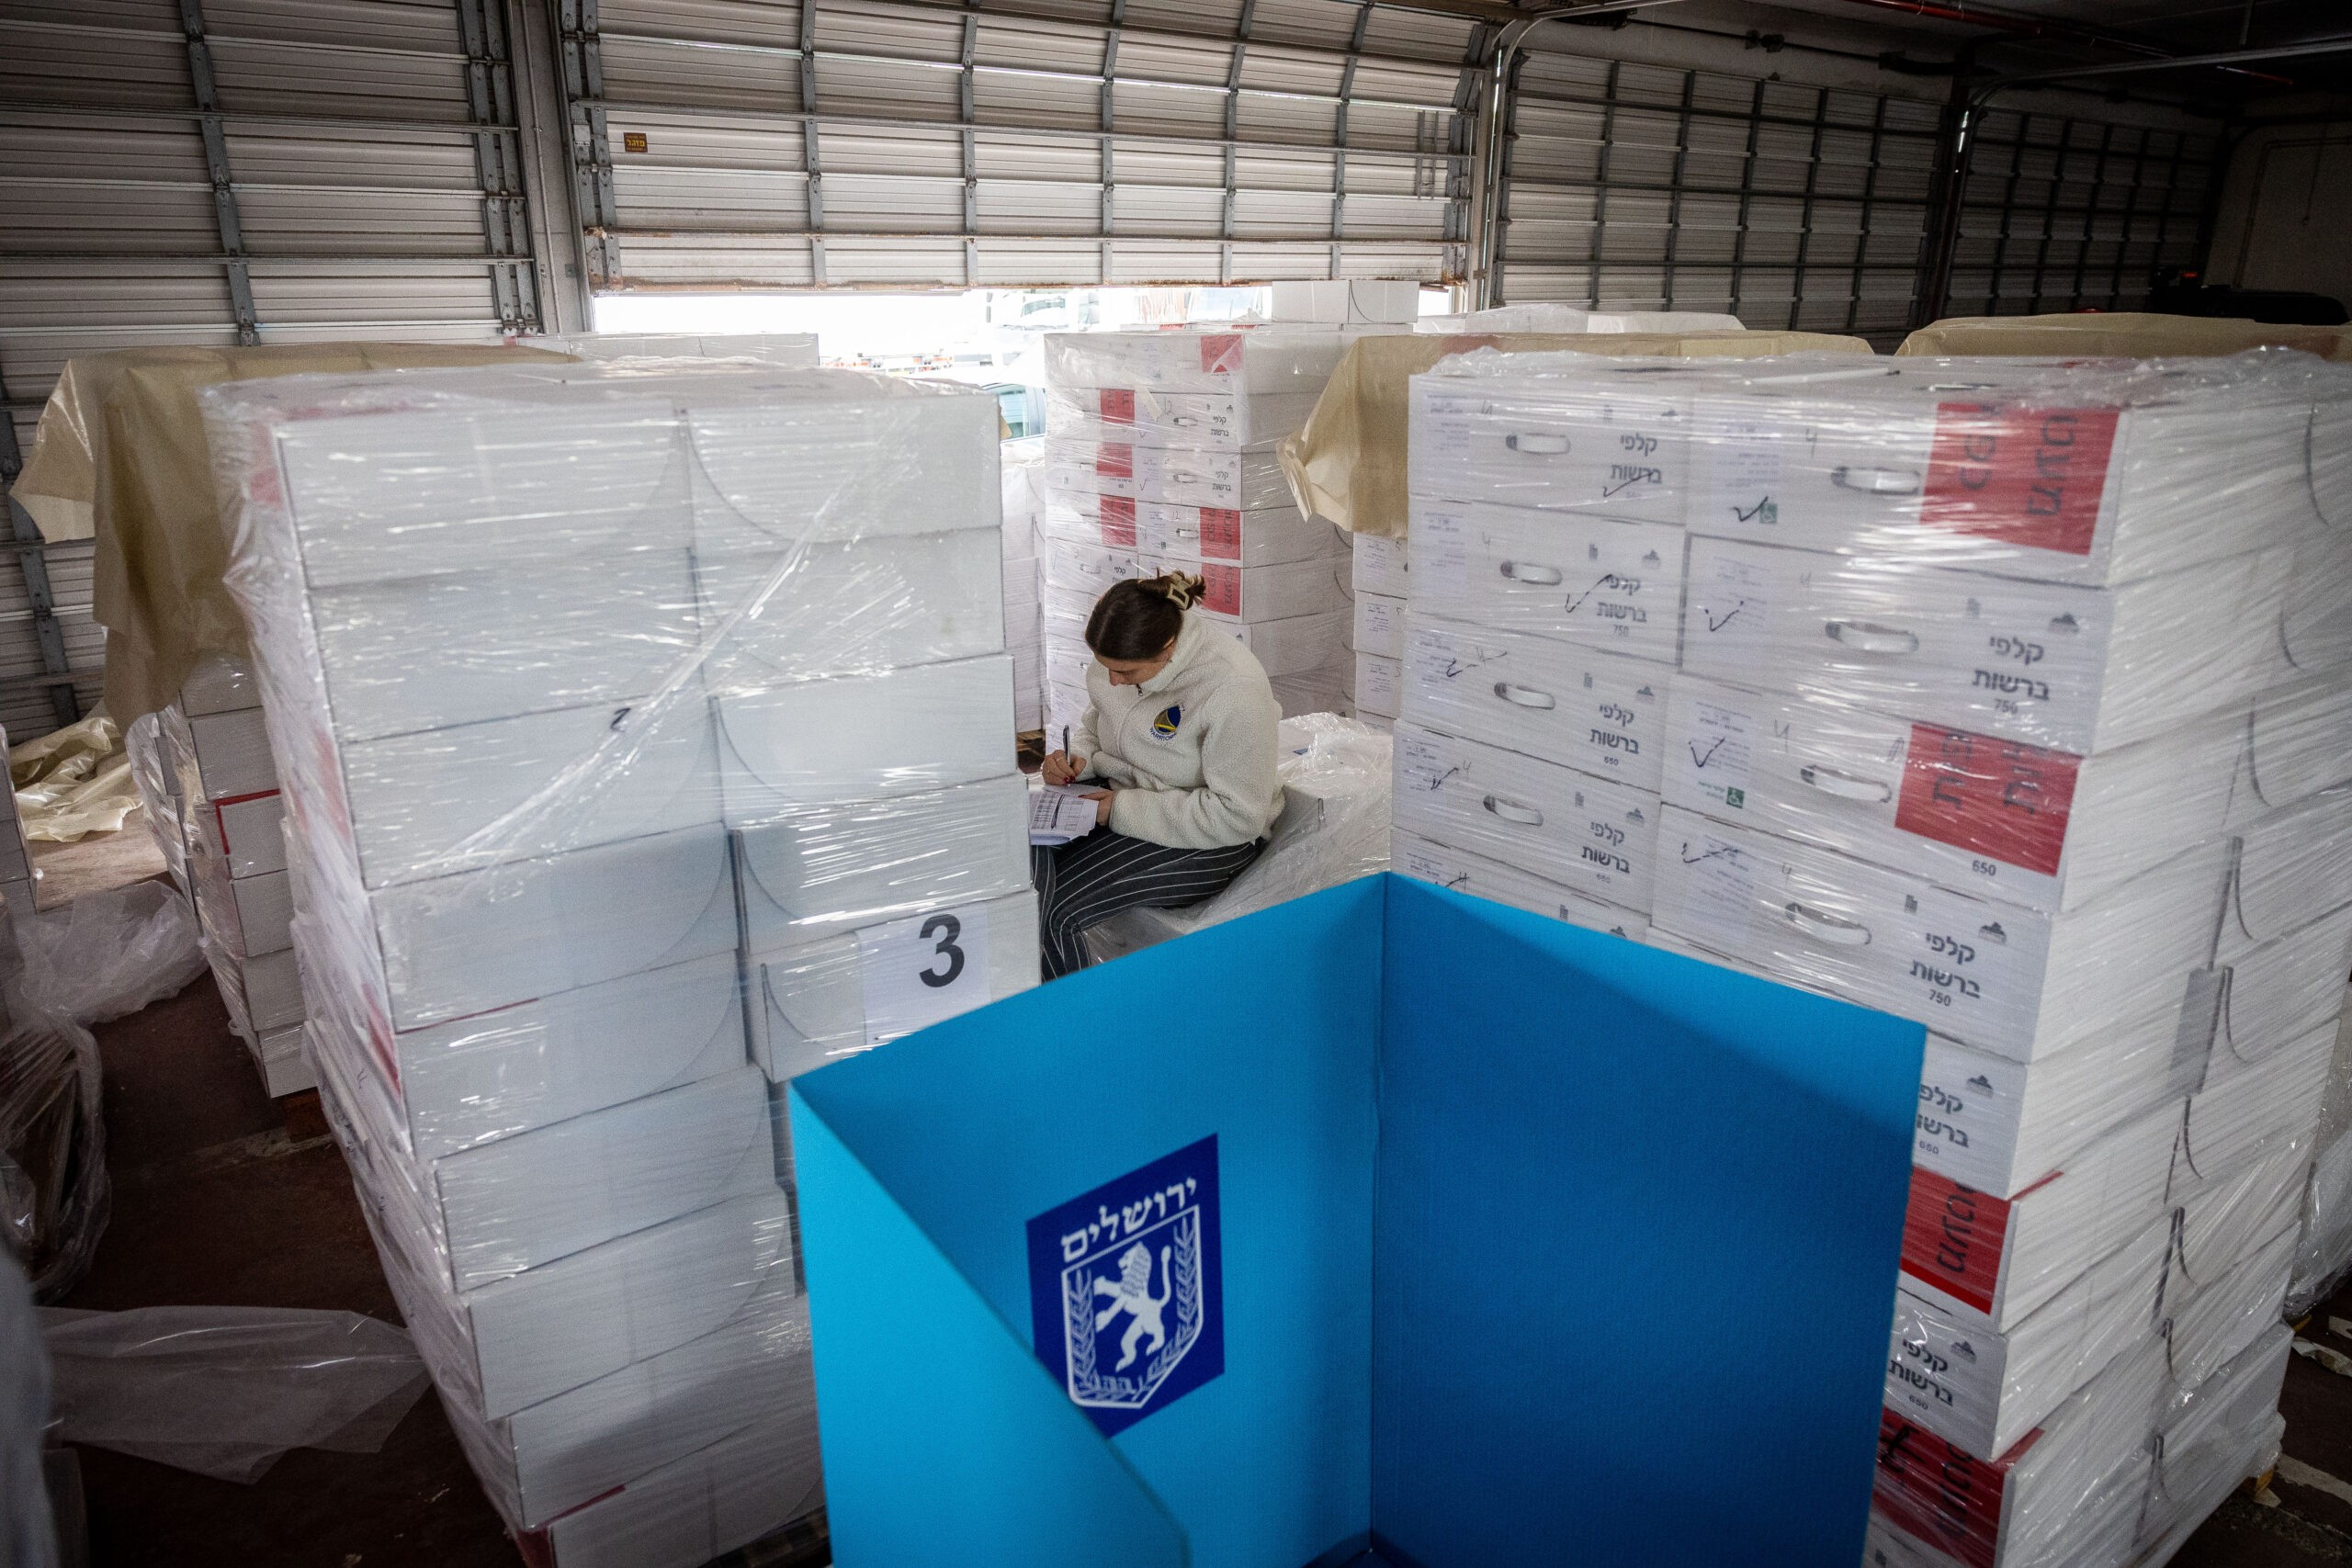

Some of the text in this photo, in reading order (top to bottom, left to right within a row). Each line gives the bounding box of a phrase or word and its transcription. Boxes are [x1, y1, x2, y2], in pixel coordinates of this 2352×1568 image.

[1210, 428, 1229, 436] ברשות
[1213, 414, 1227, 425] קלפי
[1620, 433, 1657, 457] קלפי
[1611, 464, 1662, 484] ברשות
[1605, 575, 1641, 596] קלפי
[1597, 602, 1647, 623] ברשות
[1612, 624, 1629, 637] 750
[1989, 637, 2044, 665] קלפי
[1972, 669, 2049, 701] ברשות
[1599, 703, 1634, 728] קלפי
[1995, 698, 2018, 715] 750
[1589, 728, 1640, 754] ברשות
[1603, 756, 1619, 766] 650
[1590, 821, 1625, 846] קלפי
[1581, 845, 1631, 874] ברשות
[1972, 860, 1996, 876] 650
[919, 913, 965, 987] 3
[1926, 932, 1975, 965] קלפי
[1909, 959, 1981, 999] ברשות
[1928, 988, 1951, 1007] 750
[1919, 1084, 1963, 1114] קלפ
[1917, 1113, 1969, 1148] ברשו
[1060, 1177, 1197, 1263] ירושלים
[1903, 1338, 1948, 1372] קלפי
[1888, 1359, 1953, 1407] ברשות
